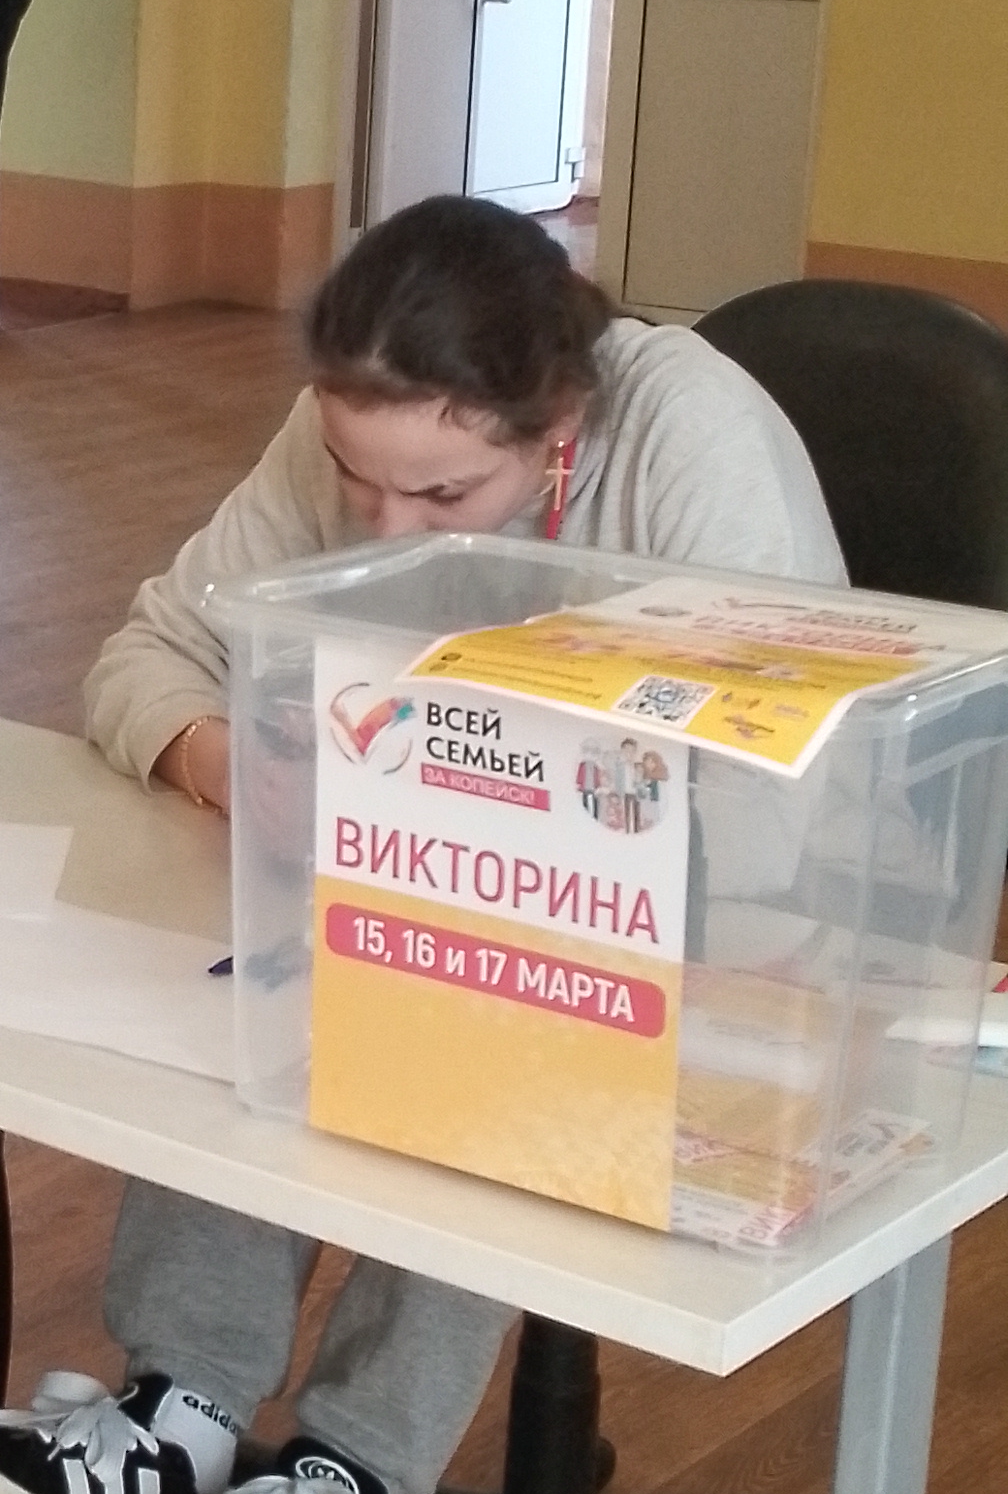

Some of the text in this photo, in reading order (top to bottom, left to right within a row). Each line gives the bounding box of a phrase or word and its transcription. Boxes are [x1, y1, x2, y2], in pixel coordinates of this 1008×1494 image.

[426, 702, 502, 741] ВСЕЙ
[424, 768, 447, 785] ЗА
[426, 736, 545, 783] СЕМЬЕЙ
[335, 816, 660, 944] ВИКТОРИНА
[352, 916, 635, 1023] 15, 16 и 17 МАРТА
[182, 1393, 237, 1435] adida
